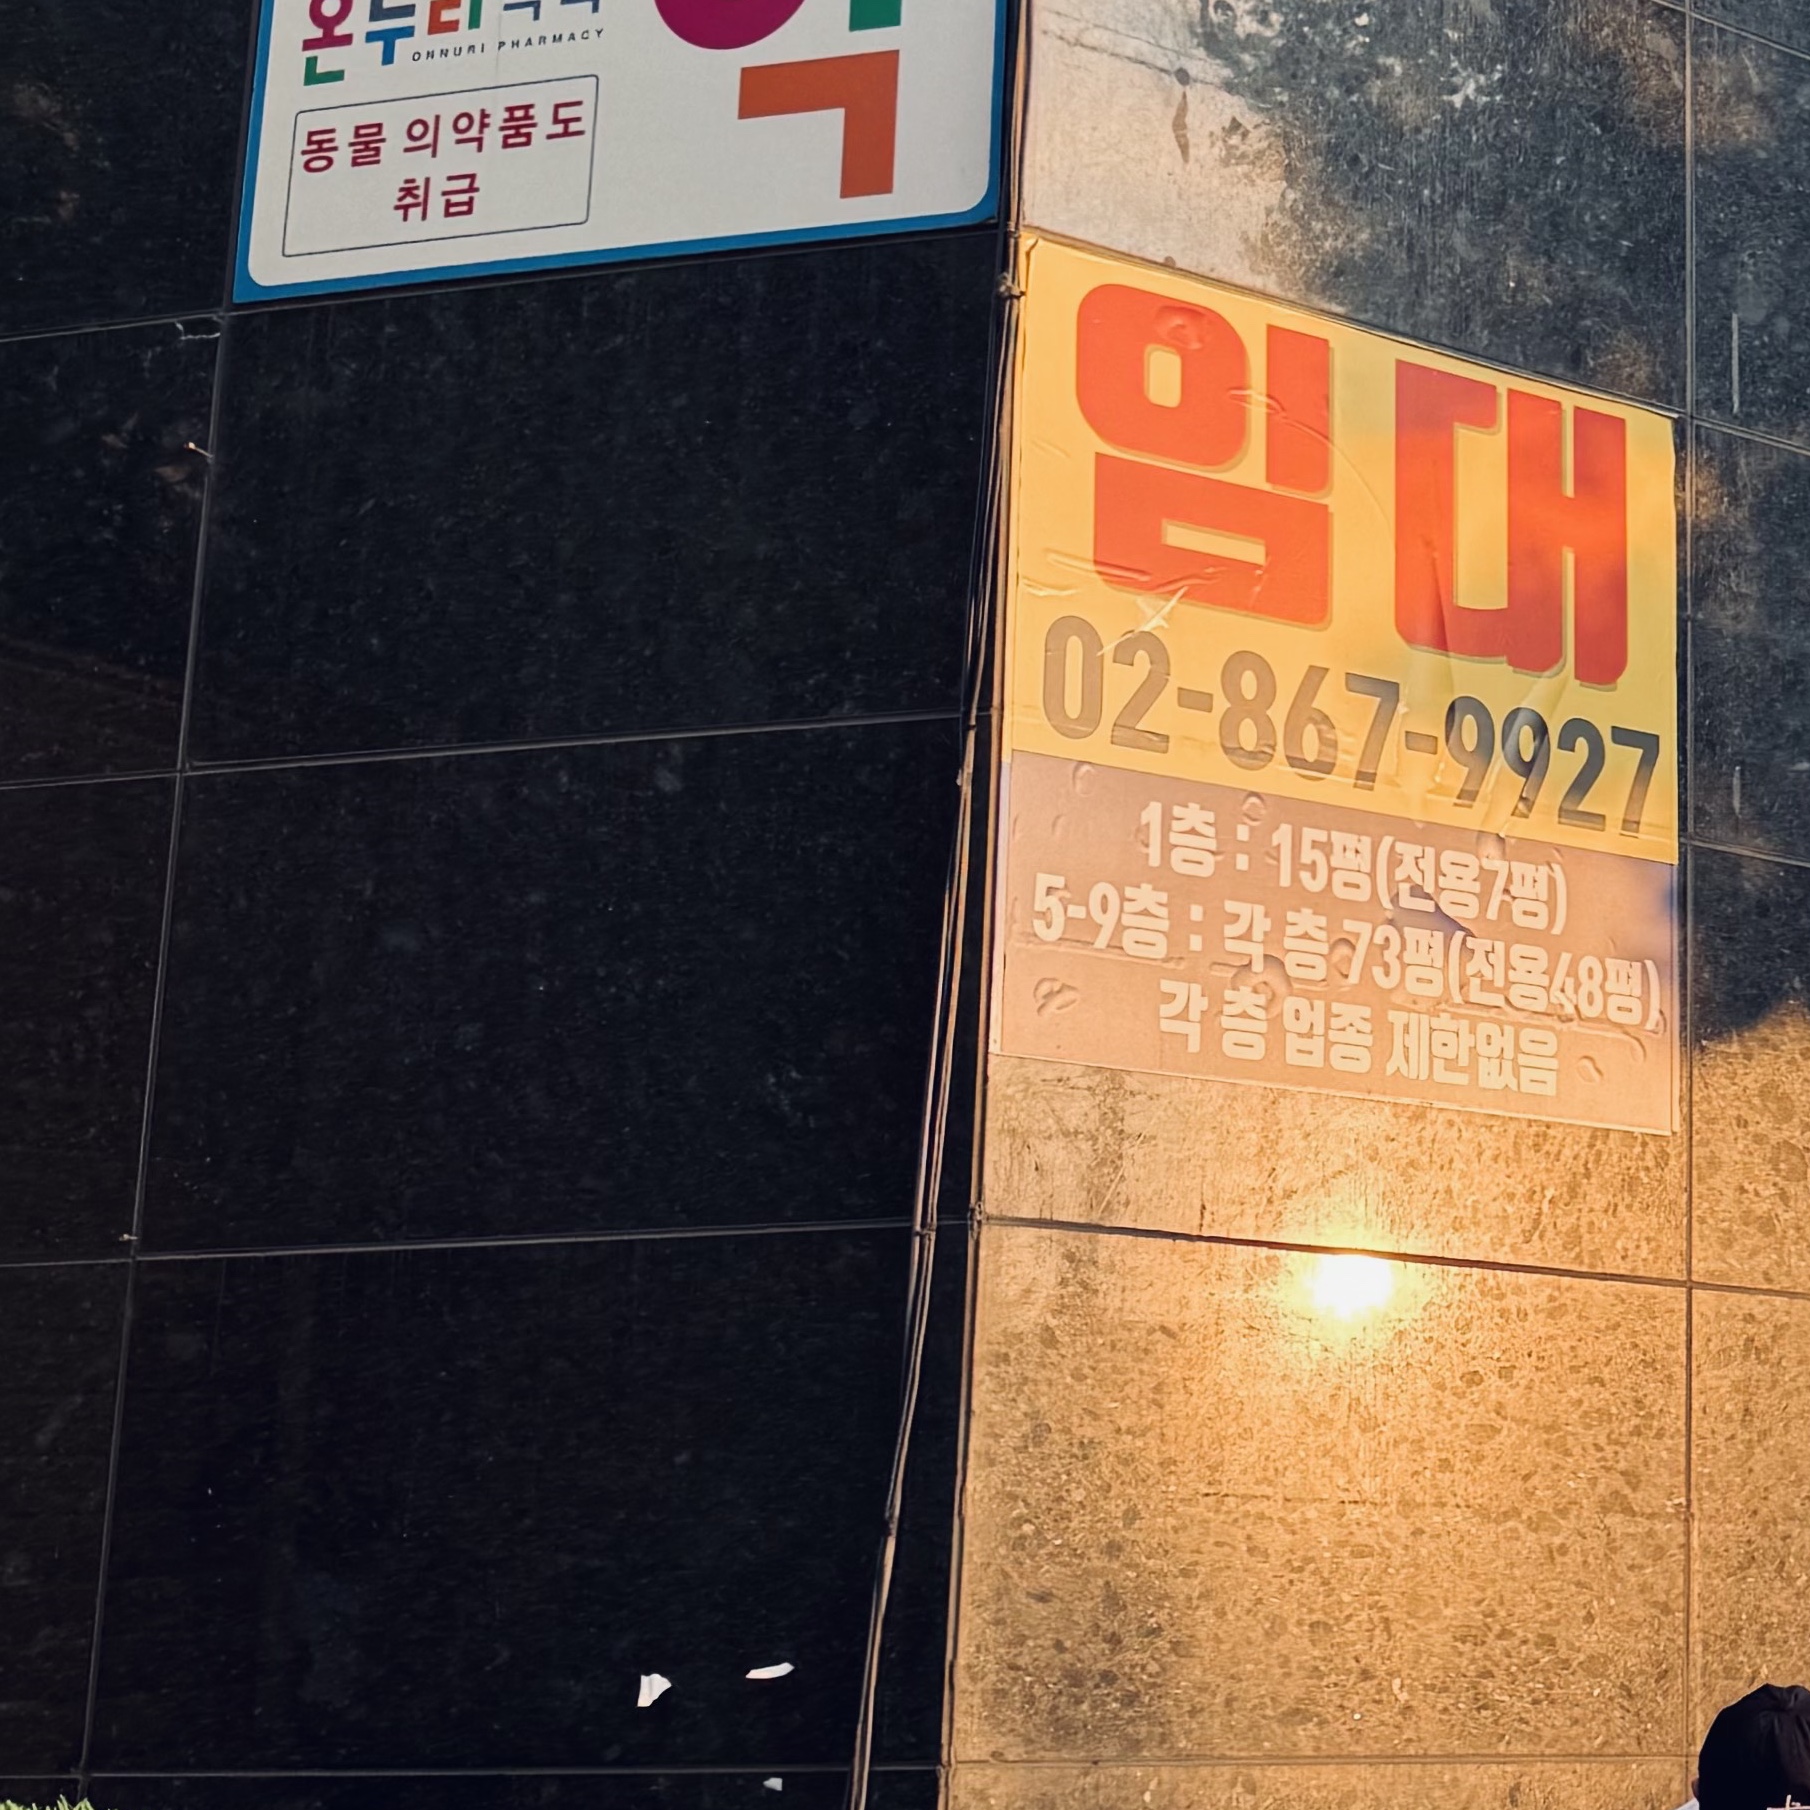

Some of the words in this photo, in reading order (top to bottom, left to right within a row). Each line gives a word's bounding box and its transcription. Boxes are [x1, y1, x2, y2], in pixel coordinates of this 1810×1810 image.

[301, 0, 600, 86] 온누리
[412, 43, 486, 62] ONNURI
[497, 28, 605, 51] PHARMACY
[393, 172, 481, 223] 취급
[1075, 283, 1630, 693] 임대
[1042, 615, 1662, 838] 02-867-9927
[1139, 800, 1218, 878] 1층
[1271, 822, 1569, 935] 15평(전용7평)
[1032, 873, 1172, 960] 5-9층
[1283, 1001, 1374, 1074] 업종
[1386, 1008, 1560, 1096] 제한없음
